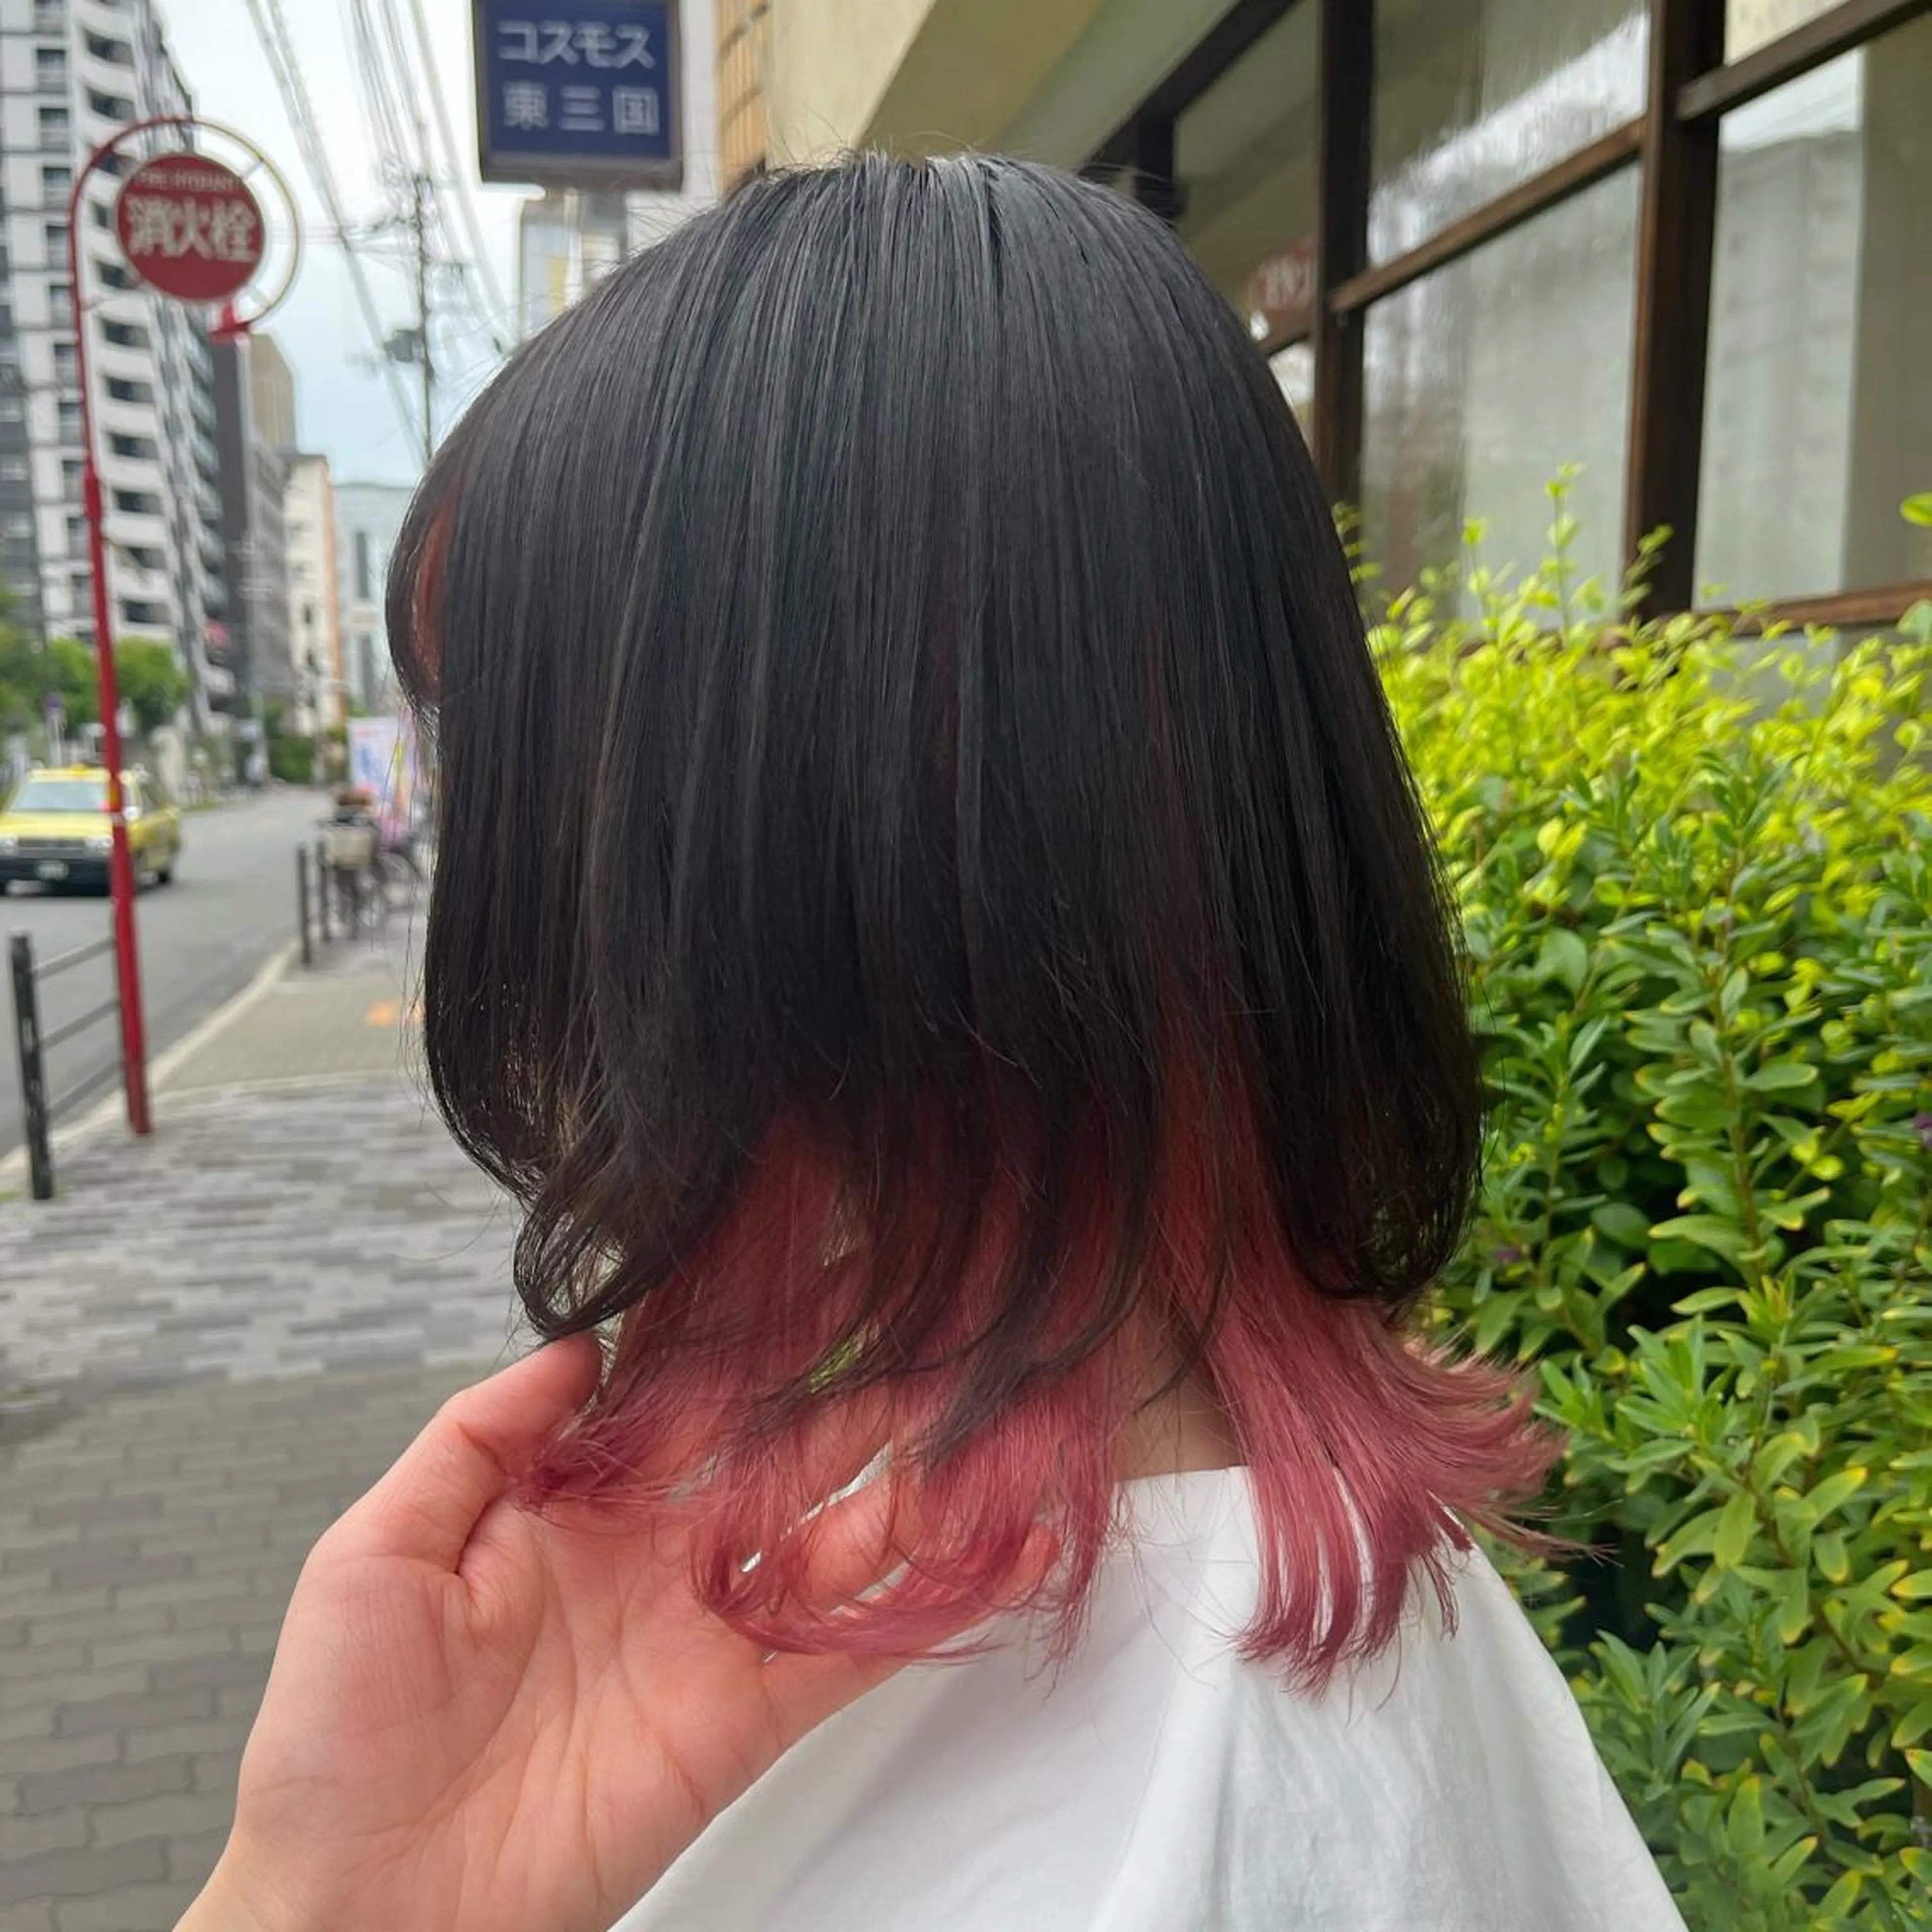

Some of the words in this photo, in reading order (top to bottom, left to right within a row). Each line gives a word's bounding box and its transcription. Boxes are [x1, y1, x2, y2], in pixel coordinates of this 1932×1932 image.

[498, 20, 655, 68] コスモス
[503, 82, 659, 135] 東三国
[128, 195, 258, 261] 消火栓
